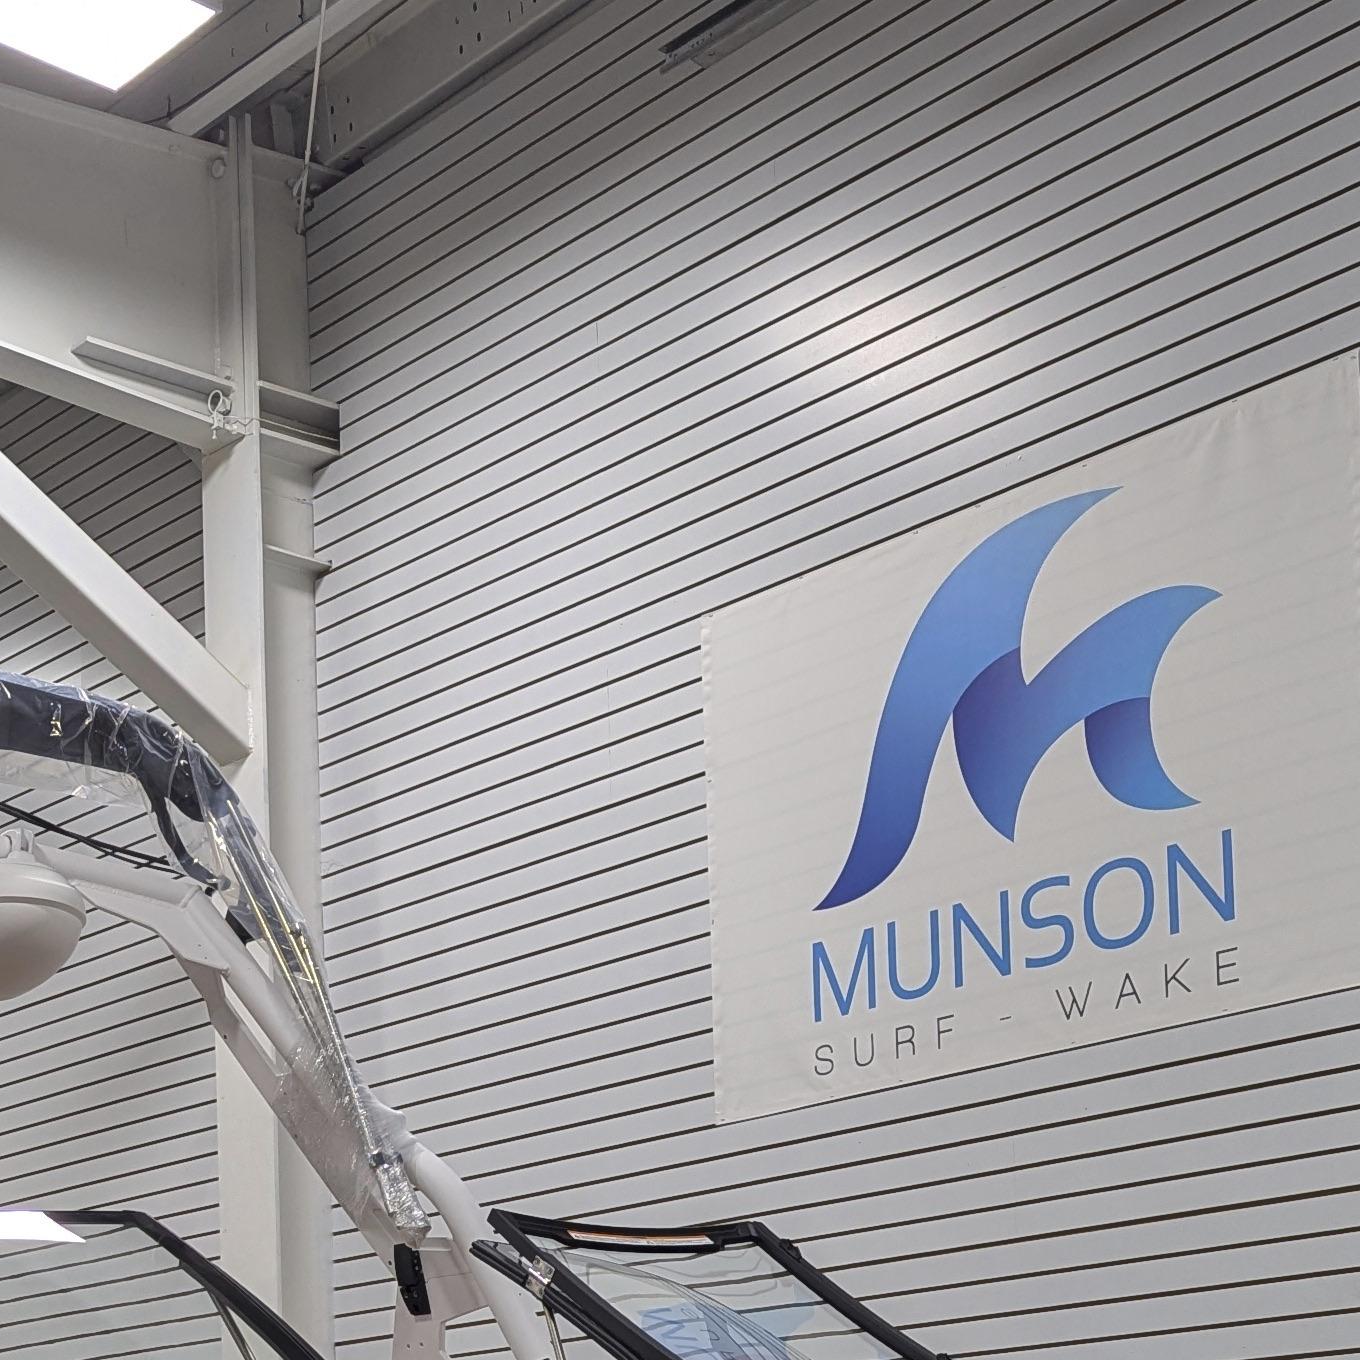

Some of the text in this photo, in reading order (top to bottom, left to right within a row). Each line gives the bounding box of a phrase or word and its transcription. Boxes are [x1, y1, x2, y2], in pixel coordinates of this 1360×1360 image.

[811, 828, 1236, 1023] MUNSON
[813, 1014, 955, 1076] SURF
[1055, 946, 1240, 1021] WAKE
